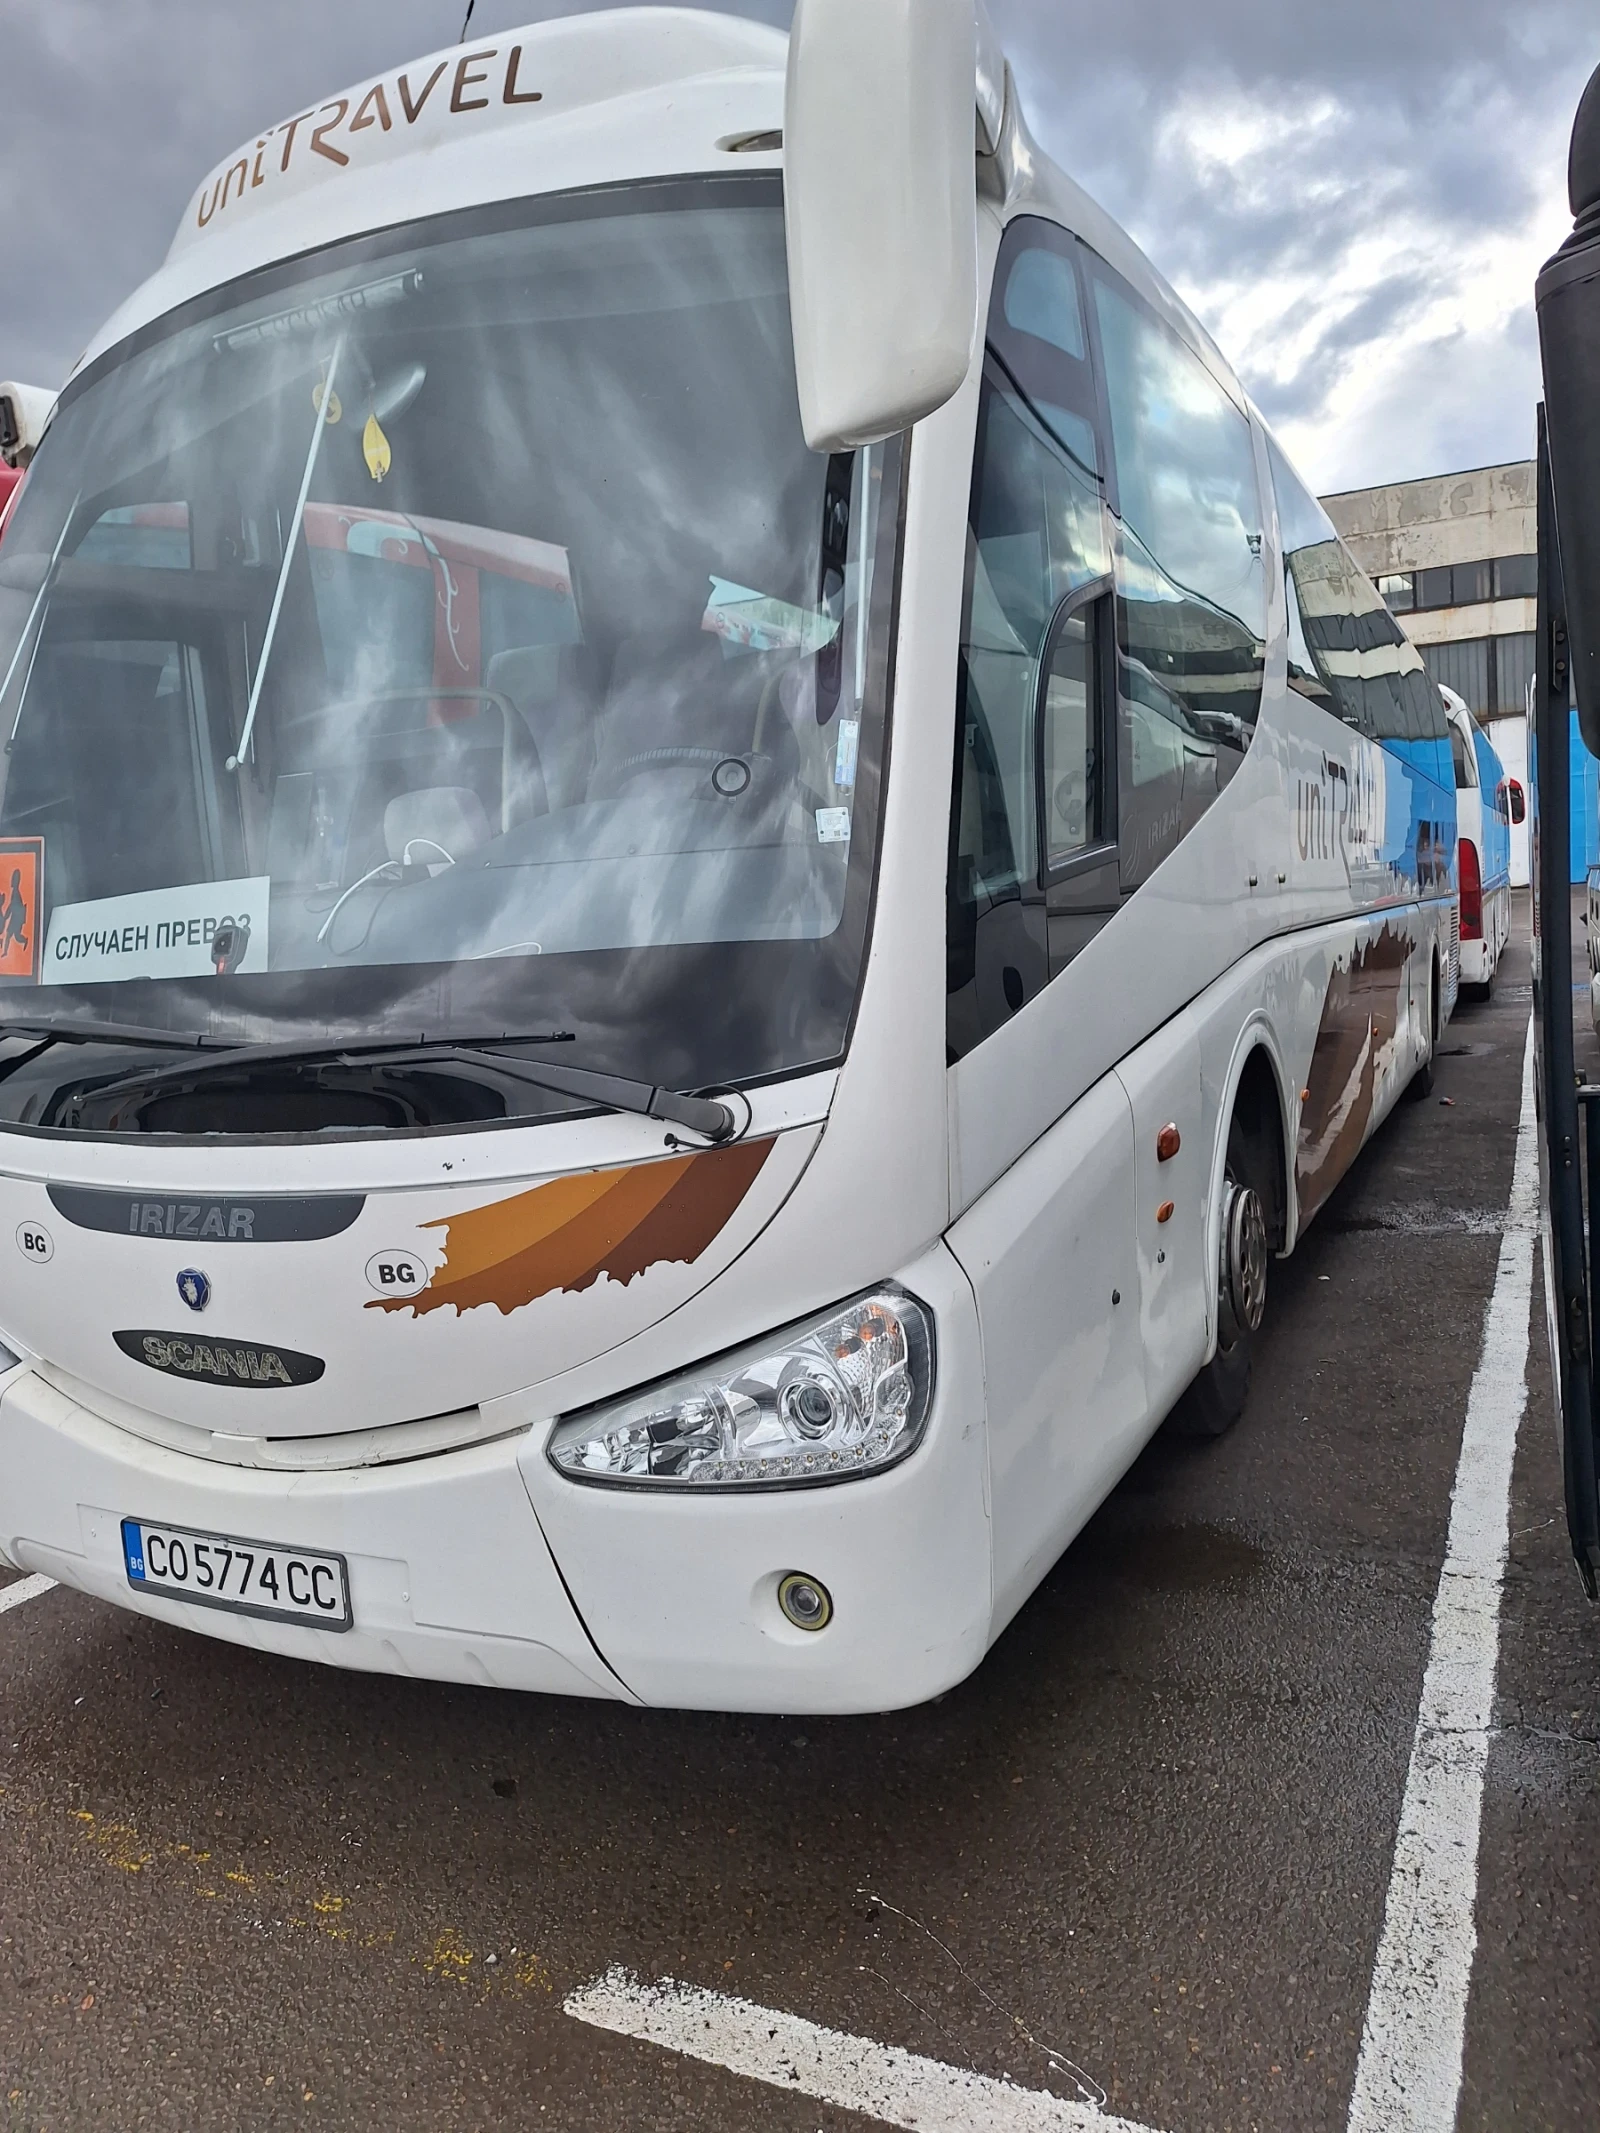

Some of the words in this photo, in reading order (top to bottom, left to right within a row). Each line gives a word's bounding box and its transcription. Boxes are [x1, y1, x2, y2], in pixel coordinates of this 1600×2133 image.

[55, 924, 149, 960] СЛУЧАЕН
[129, 1203, 255, 1238] IRIZAR
[24, 1232, 47, 1254] BG
[378, 1263, 416, 1284] BG
[142, 1336, 293, 1383] SCANIA
[130, 1556, 144, 1571] BG
